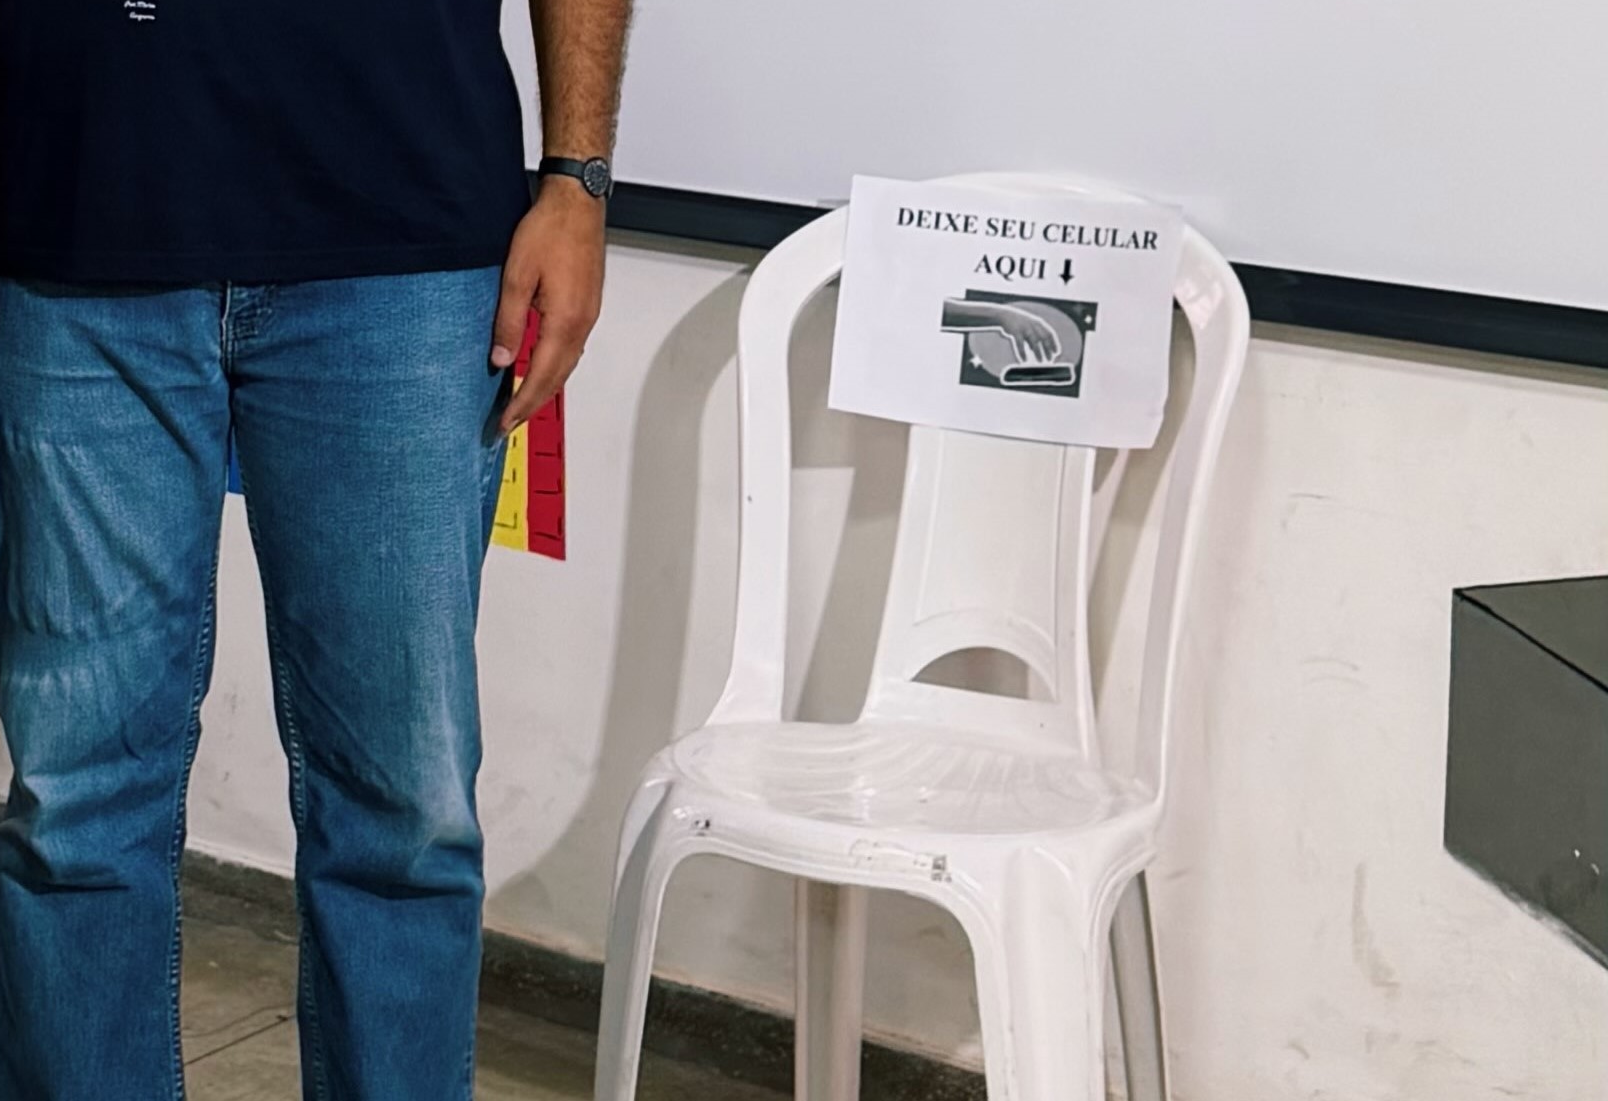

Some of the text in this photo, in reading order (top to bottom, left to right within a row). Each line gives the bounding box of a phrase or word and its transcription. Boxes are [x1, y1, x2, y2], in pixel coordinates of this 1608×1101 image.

[897, 207, 1158, 250] DEIXE SEU CELULAR
[974, 253, 1046, 281] AQUI
